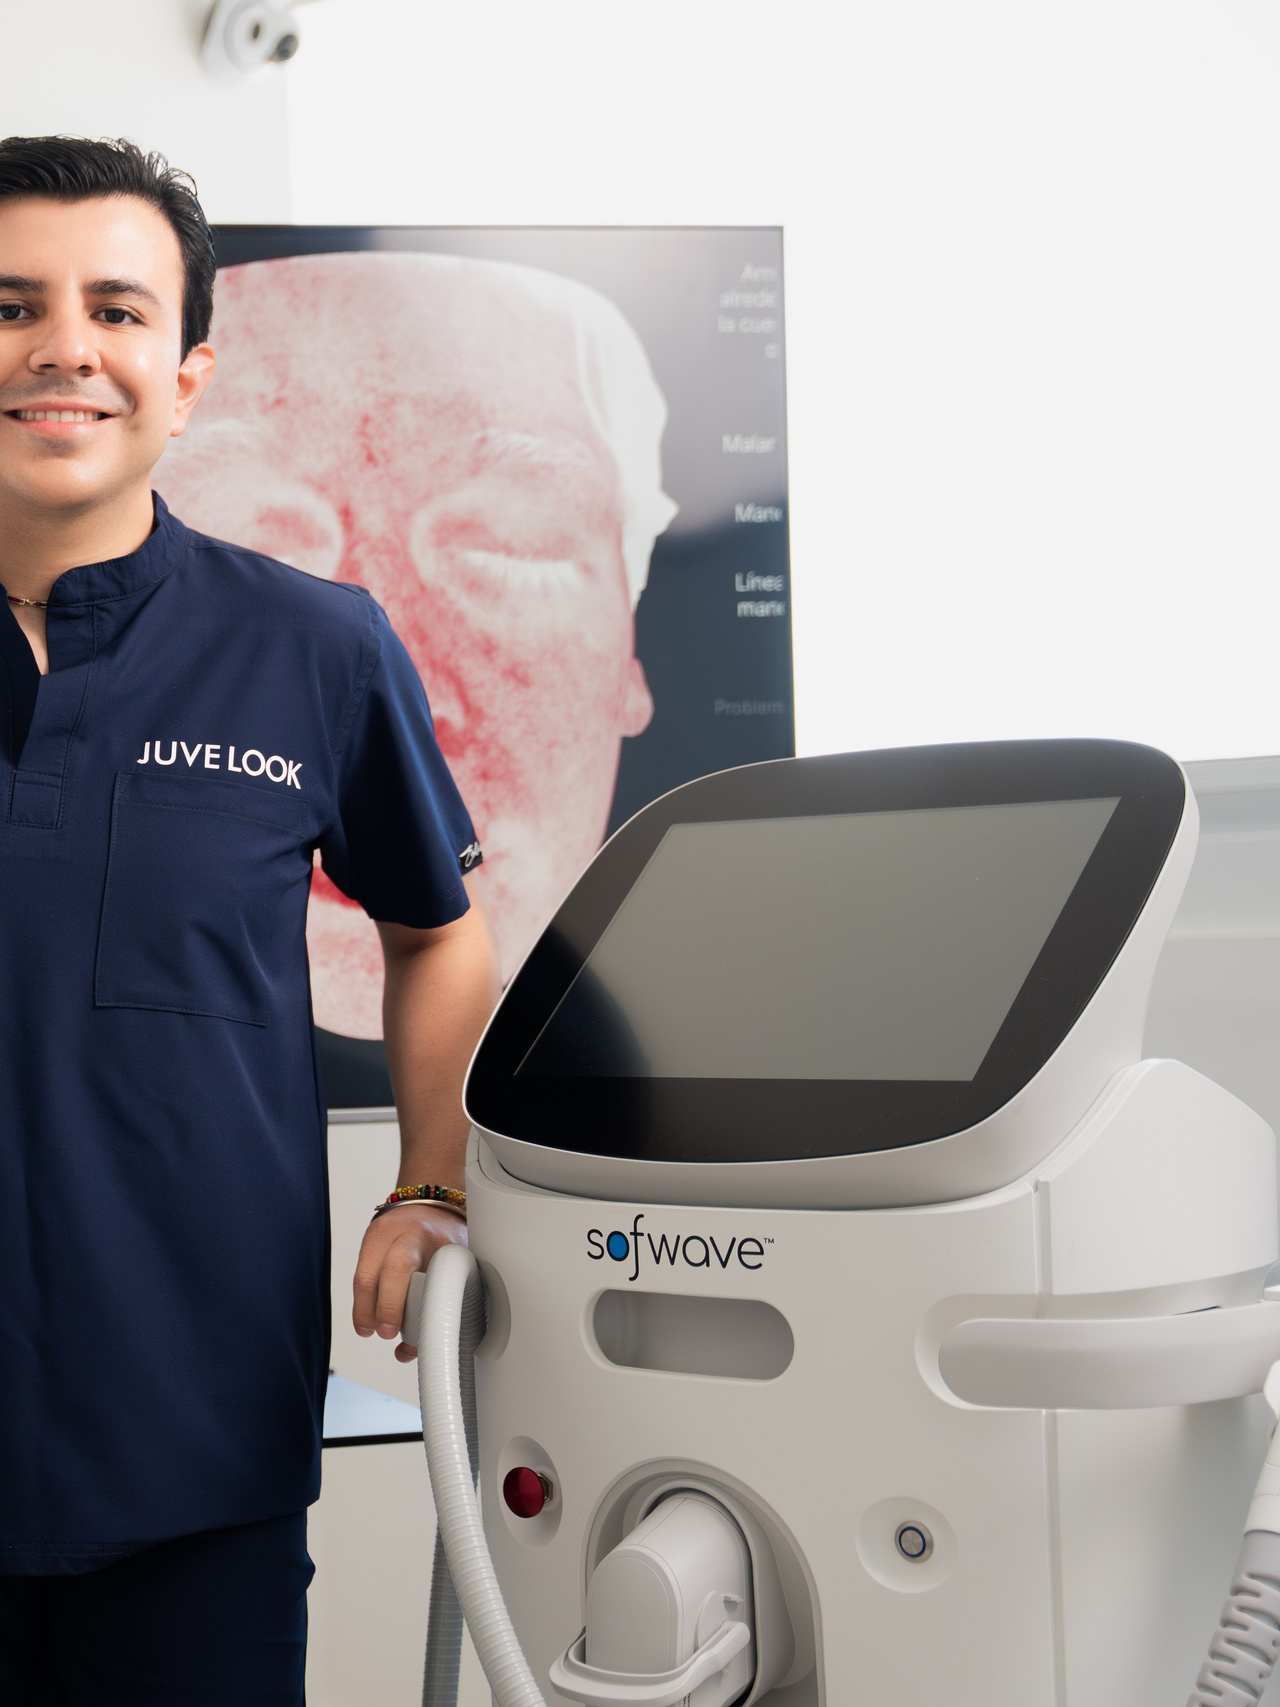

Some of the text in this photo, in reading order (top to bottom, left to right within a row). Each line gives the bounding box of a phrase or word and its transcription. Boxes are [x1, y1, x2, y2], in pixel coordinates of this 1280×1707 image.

[722, 433, 776, 454] Malar
[136, 740, 303, 790] JUVE LOOK
